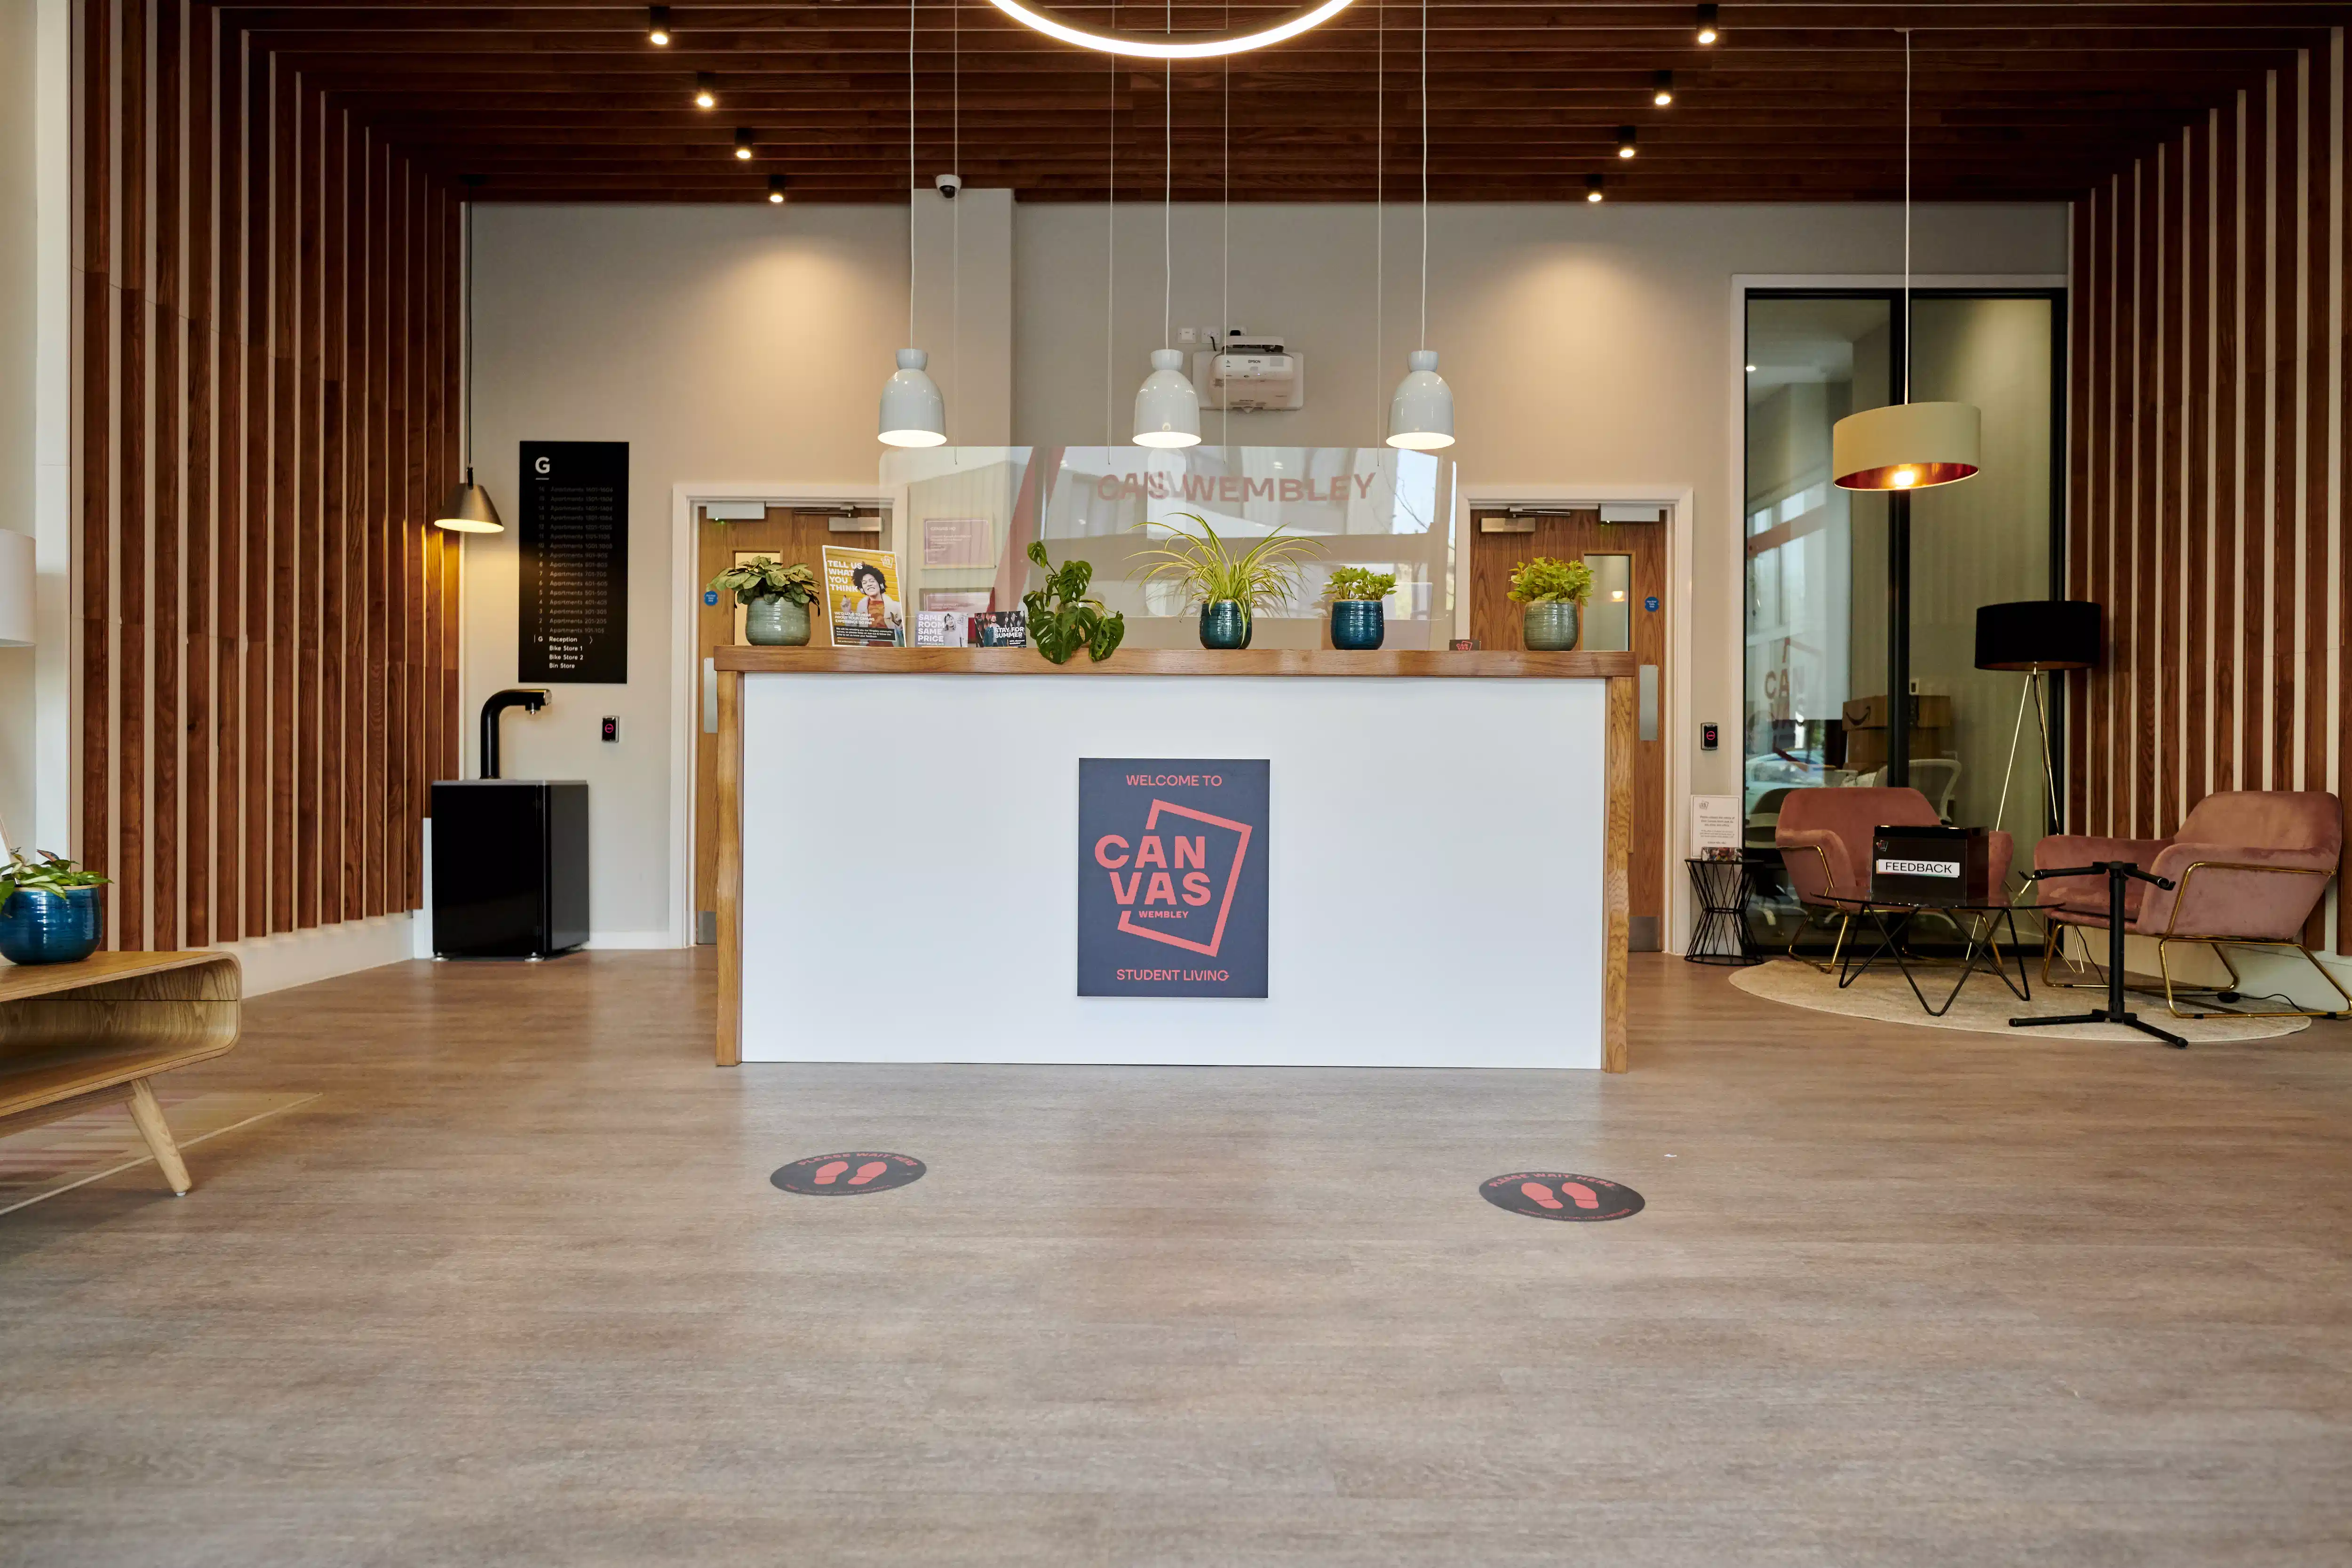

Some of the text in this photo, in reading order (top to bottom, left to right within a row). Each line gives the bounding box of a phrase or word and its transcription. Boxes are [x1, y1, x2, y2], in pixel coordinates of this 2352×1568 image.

[535, 456, 550, 473] G
[1183, 472, 1376, 502] WEMBLEY
[830, 584, 858, 592] THINK
[1126, 775, 1222, 787] WELCOME TO
[1095, 835, 1205, 869] CAN
[1886, 862, 1952, 874] FEEDBACK
[1109, 871, 1211, 906] VAS
[1116, 969, 1230, 981] STUDENT LIVING
[797, 1154, 850, 1165] PLEASE
